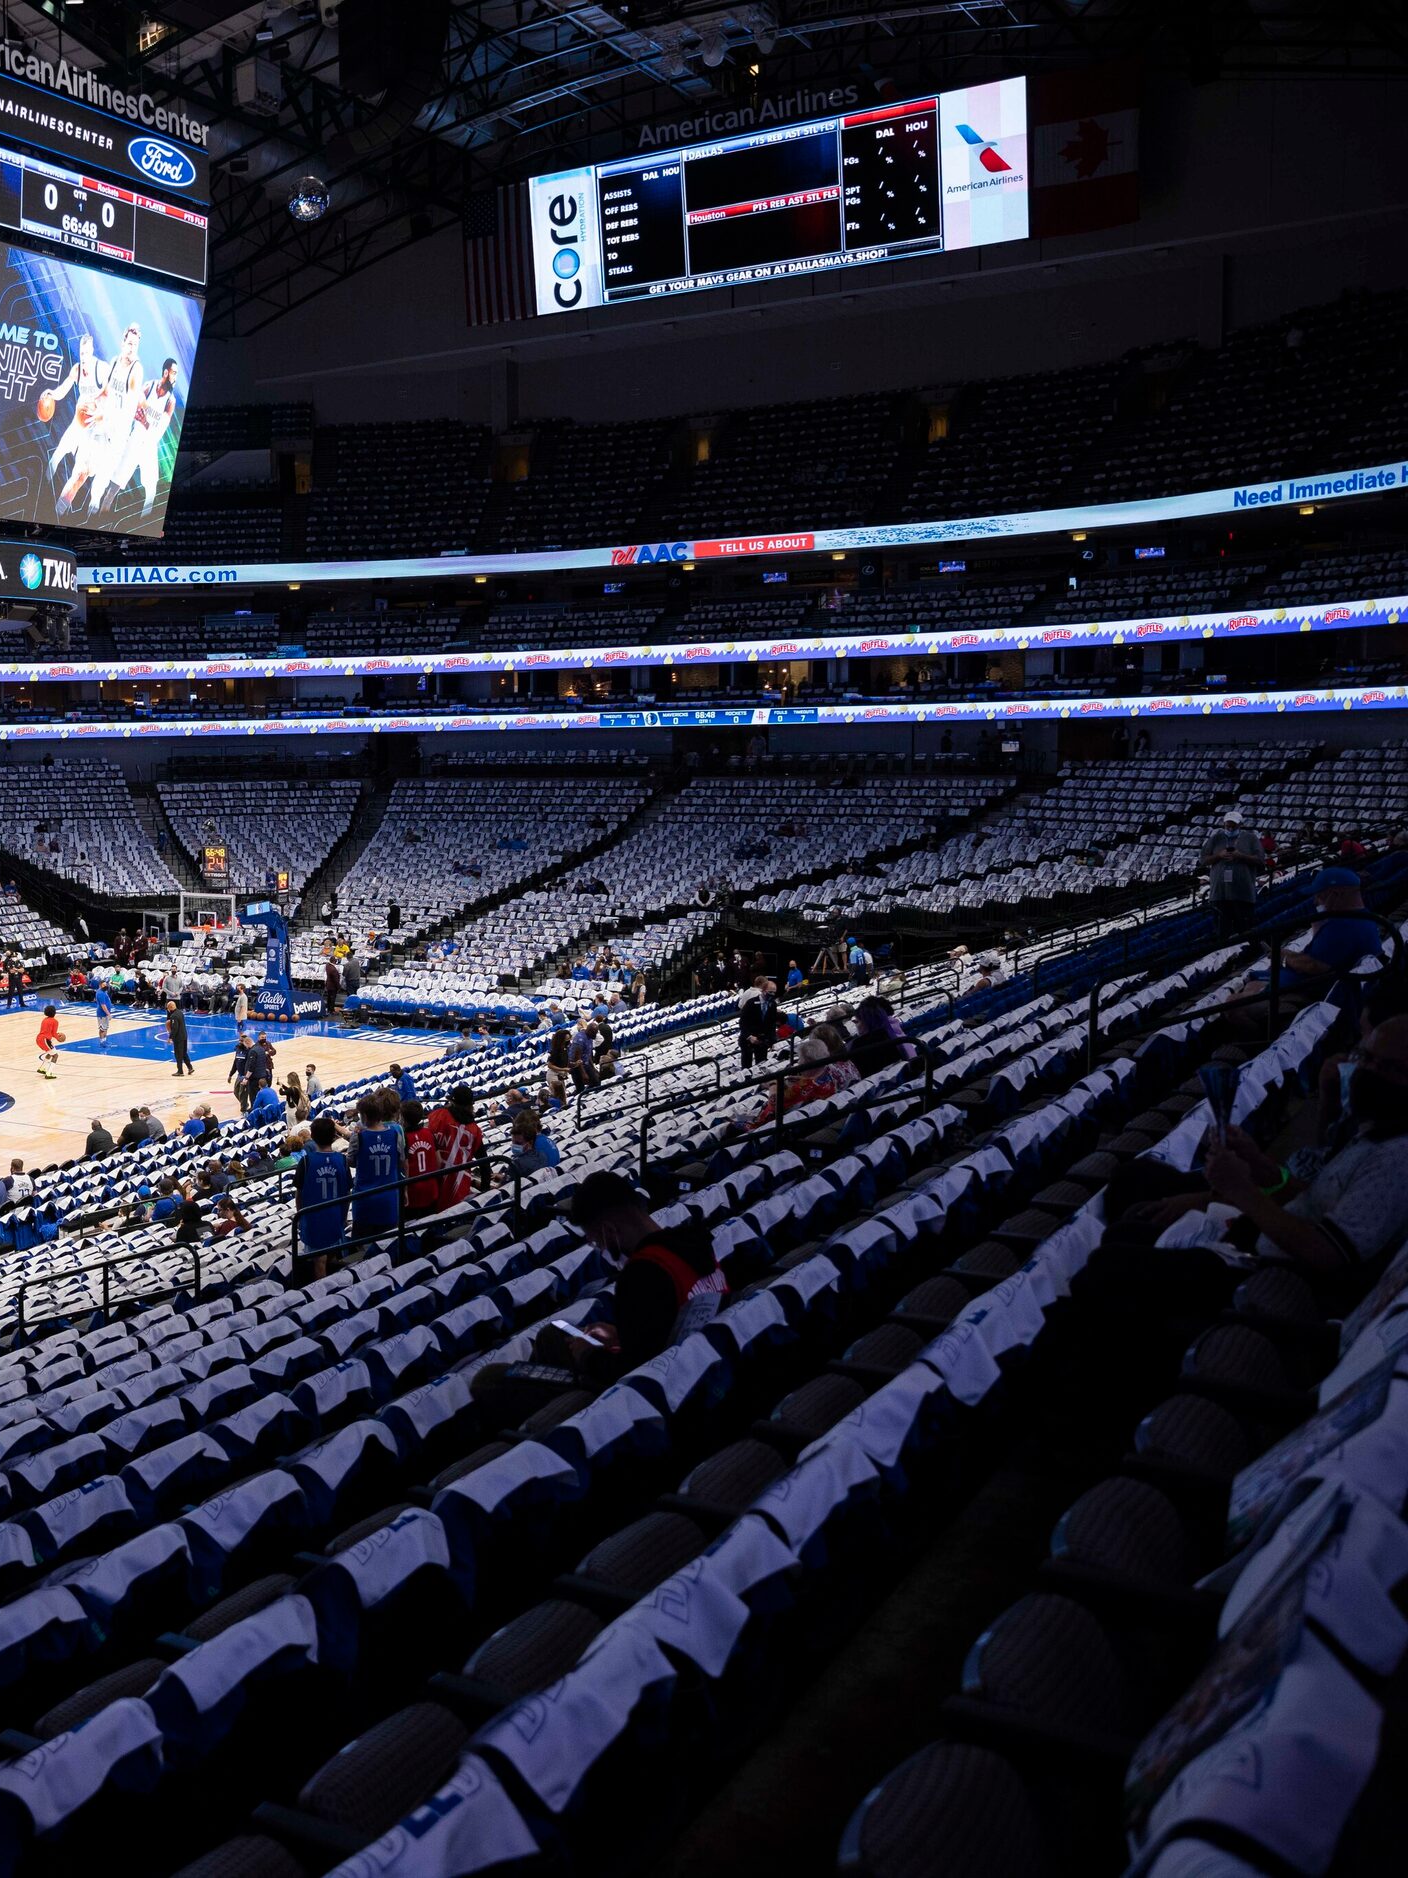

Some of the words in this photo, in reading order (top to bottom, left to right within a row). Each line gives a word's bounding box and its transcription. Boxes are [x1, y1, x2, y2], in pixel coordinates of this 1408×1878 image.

[638, 105, 754, 149] American
[758, 82, 859, 123] Airlines
[749, 135, 765, 147] PTS
[766, 132, 783, 144] REB
[784, 128, 801, 140] AST
[803, 125, 818, 136] STL
[820, 121, 835, 133] FLS
[875, 128, 895, 139] DAL
[905, 120, 928, 133] HOU
[688, 145, 724, 161] DALLAS
[141, 144, 183, 183] Ford
[844, 157, 859, 166] FGs
[642, 171, 659, 182] DAL
[663, 165, 680, 177] HOU
[97, 183, 119, 198] Rockets
[845, 186, 861, 196] 3PT
[946, 178, 989, 195] American
[989, 173, 1024, 187] Airlines
[44, 183, 59, 211] 0
[73, 189, 88, 202] QTR
[604, 188, 632, 201] ASSISTS
[752, 201, 769, 212] PTS
[770, 198, 786, 209] REB
[787, 194, 804, 206] AST
[806, 191, 821, 203] STL
[822, 188, 838, 200] FLS
[845, 197, 861, 206] FGs
[101, 202, 115, 228] 0
[145, 200, 167, 213] PLAYER
[183, 212, 195, 223] PTS
[605, 205, 620, 216] OFF
[620, 202, 639, 213] REBS
[690, 209, 726, 224] Houston
[61, 214, 98, 240] 66:48
[605, 221, 620, 231] DEF
[620, 217, 639, 228] REBS
[846, 221, 860, 231] FTs
[71, 237, 89, 249] FOULS
[606, 235, 621, 246] TOT
[621, 232, 640, 243] REBS
[99, 244, 124, 259] TIMEOUTS
[607, 252, 618, 261] TO
[608, 265, 633, 276] STEALS
[649, 283, 666, 295] GET
[668, 278, 695, 292] YOUR
[696, 273, 724, 288] MAVS
[726, 269, 752, 283] GEAR
[754, 266, 771, 278] ON
[773, 263, 788, 275] AT
[789, 248, 888, 272] DALLASMAVS.SHOP!
[33, 330, 59, 351] TO
[1233, 484, 1283, 508] Need
[1289, 470, 1396, 500] Immediate
[611, 545, 639, 566] Tell
[637, 541, 688, 564] AAC
[718, 541, 745, 553] TELL
[748, 539, 765, 551] US
[767, 537, 808, 551] ABOUT
[42, 558, 71, 590] TXU
[92, 567, 238, 584] tellAAC.com
[1136, 623, 1164, 637] RUFFLES
[603, 651, 629, 663] RUFFLES
[128, 664, 153, 677] RUFFLES
[1080, 702, 1104, 713] RUFFLES
[390, 720, 409, 729] RUFFLES
[208, 856, 224, 871] 24
[257, 991, 287, 1006] Bally
[293, 1000, 322, 1015] betway
[369, 1154, 391, 1177] 77
[417, 1151, 426, 1173] 0
[315, 1177, 338, 1200] 77
